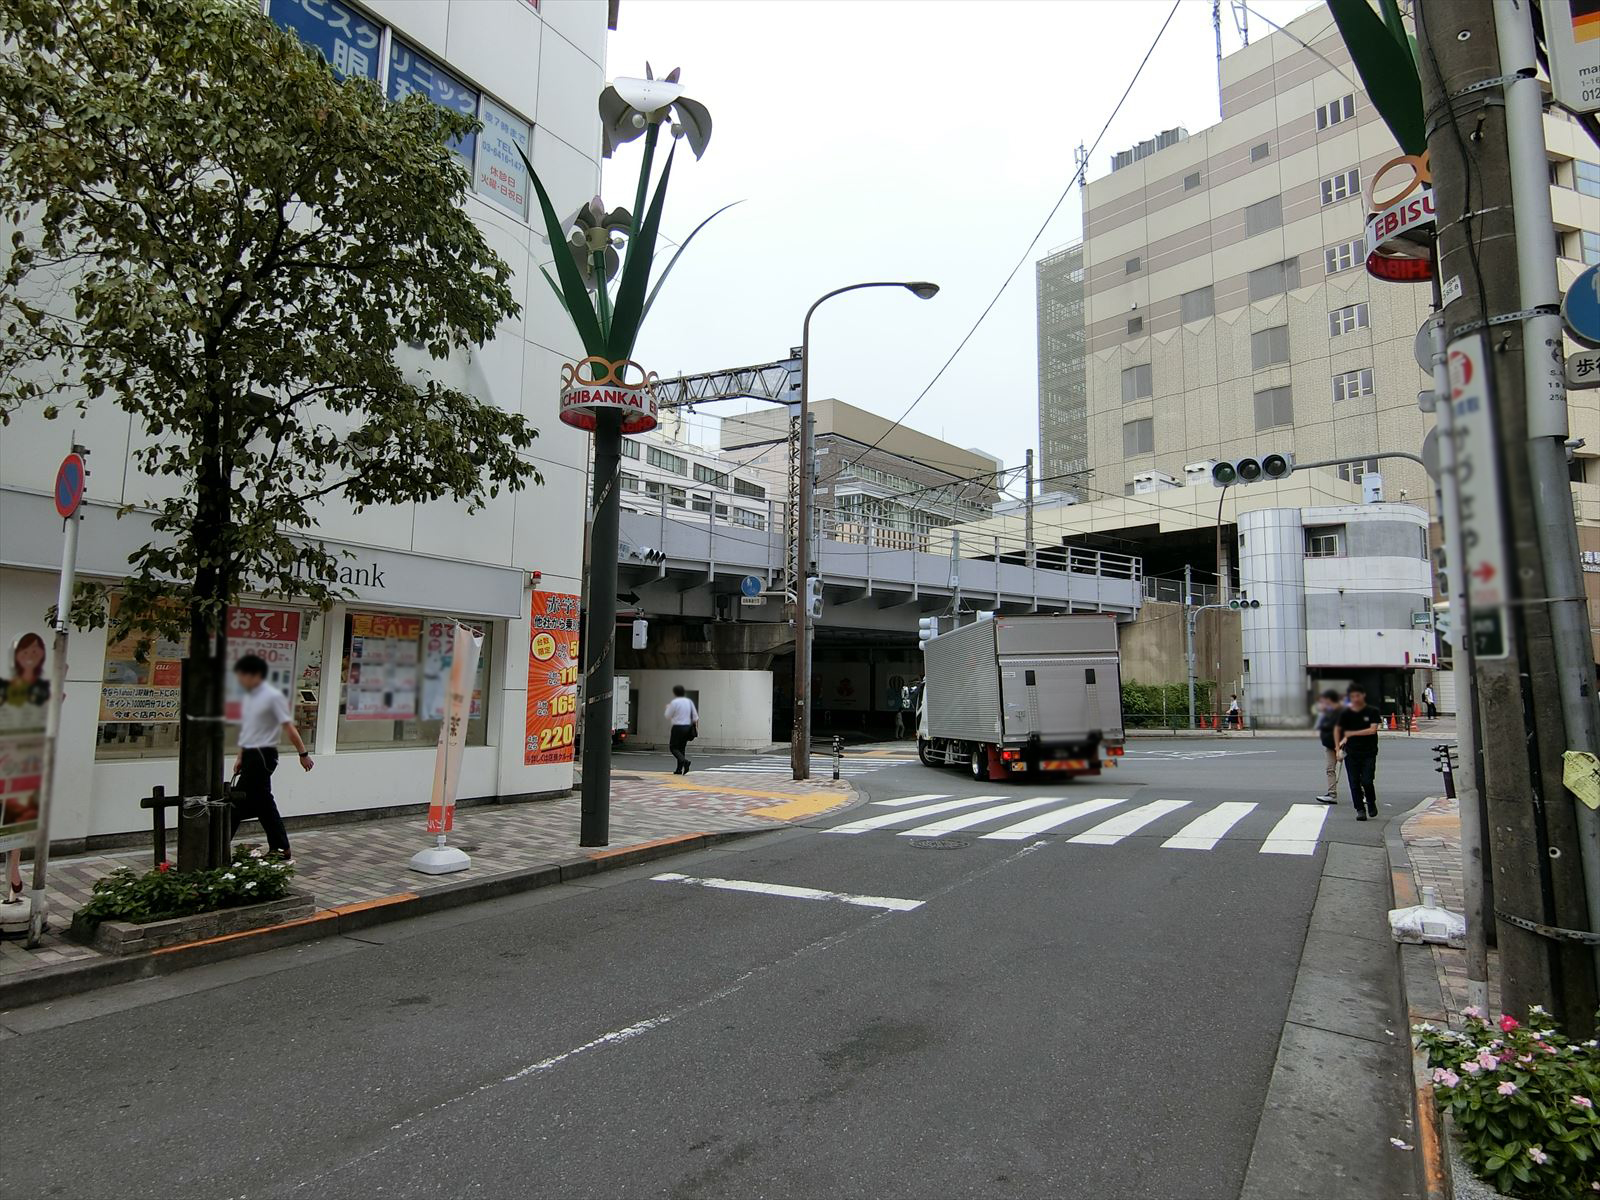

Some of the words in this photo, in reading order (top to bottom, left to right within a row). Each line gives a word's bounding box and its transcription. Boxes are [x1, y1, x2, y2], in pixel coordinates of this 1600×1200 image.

[496, 138, 513, 156] TEL
[490, 165, 516, 188] 休診日
[373, 624, 419, 641] SALE
